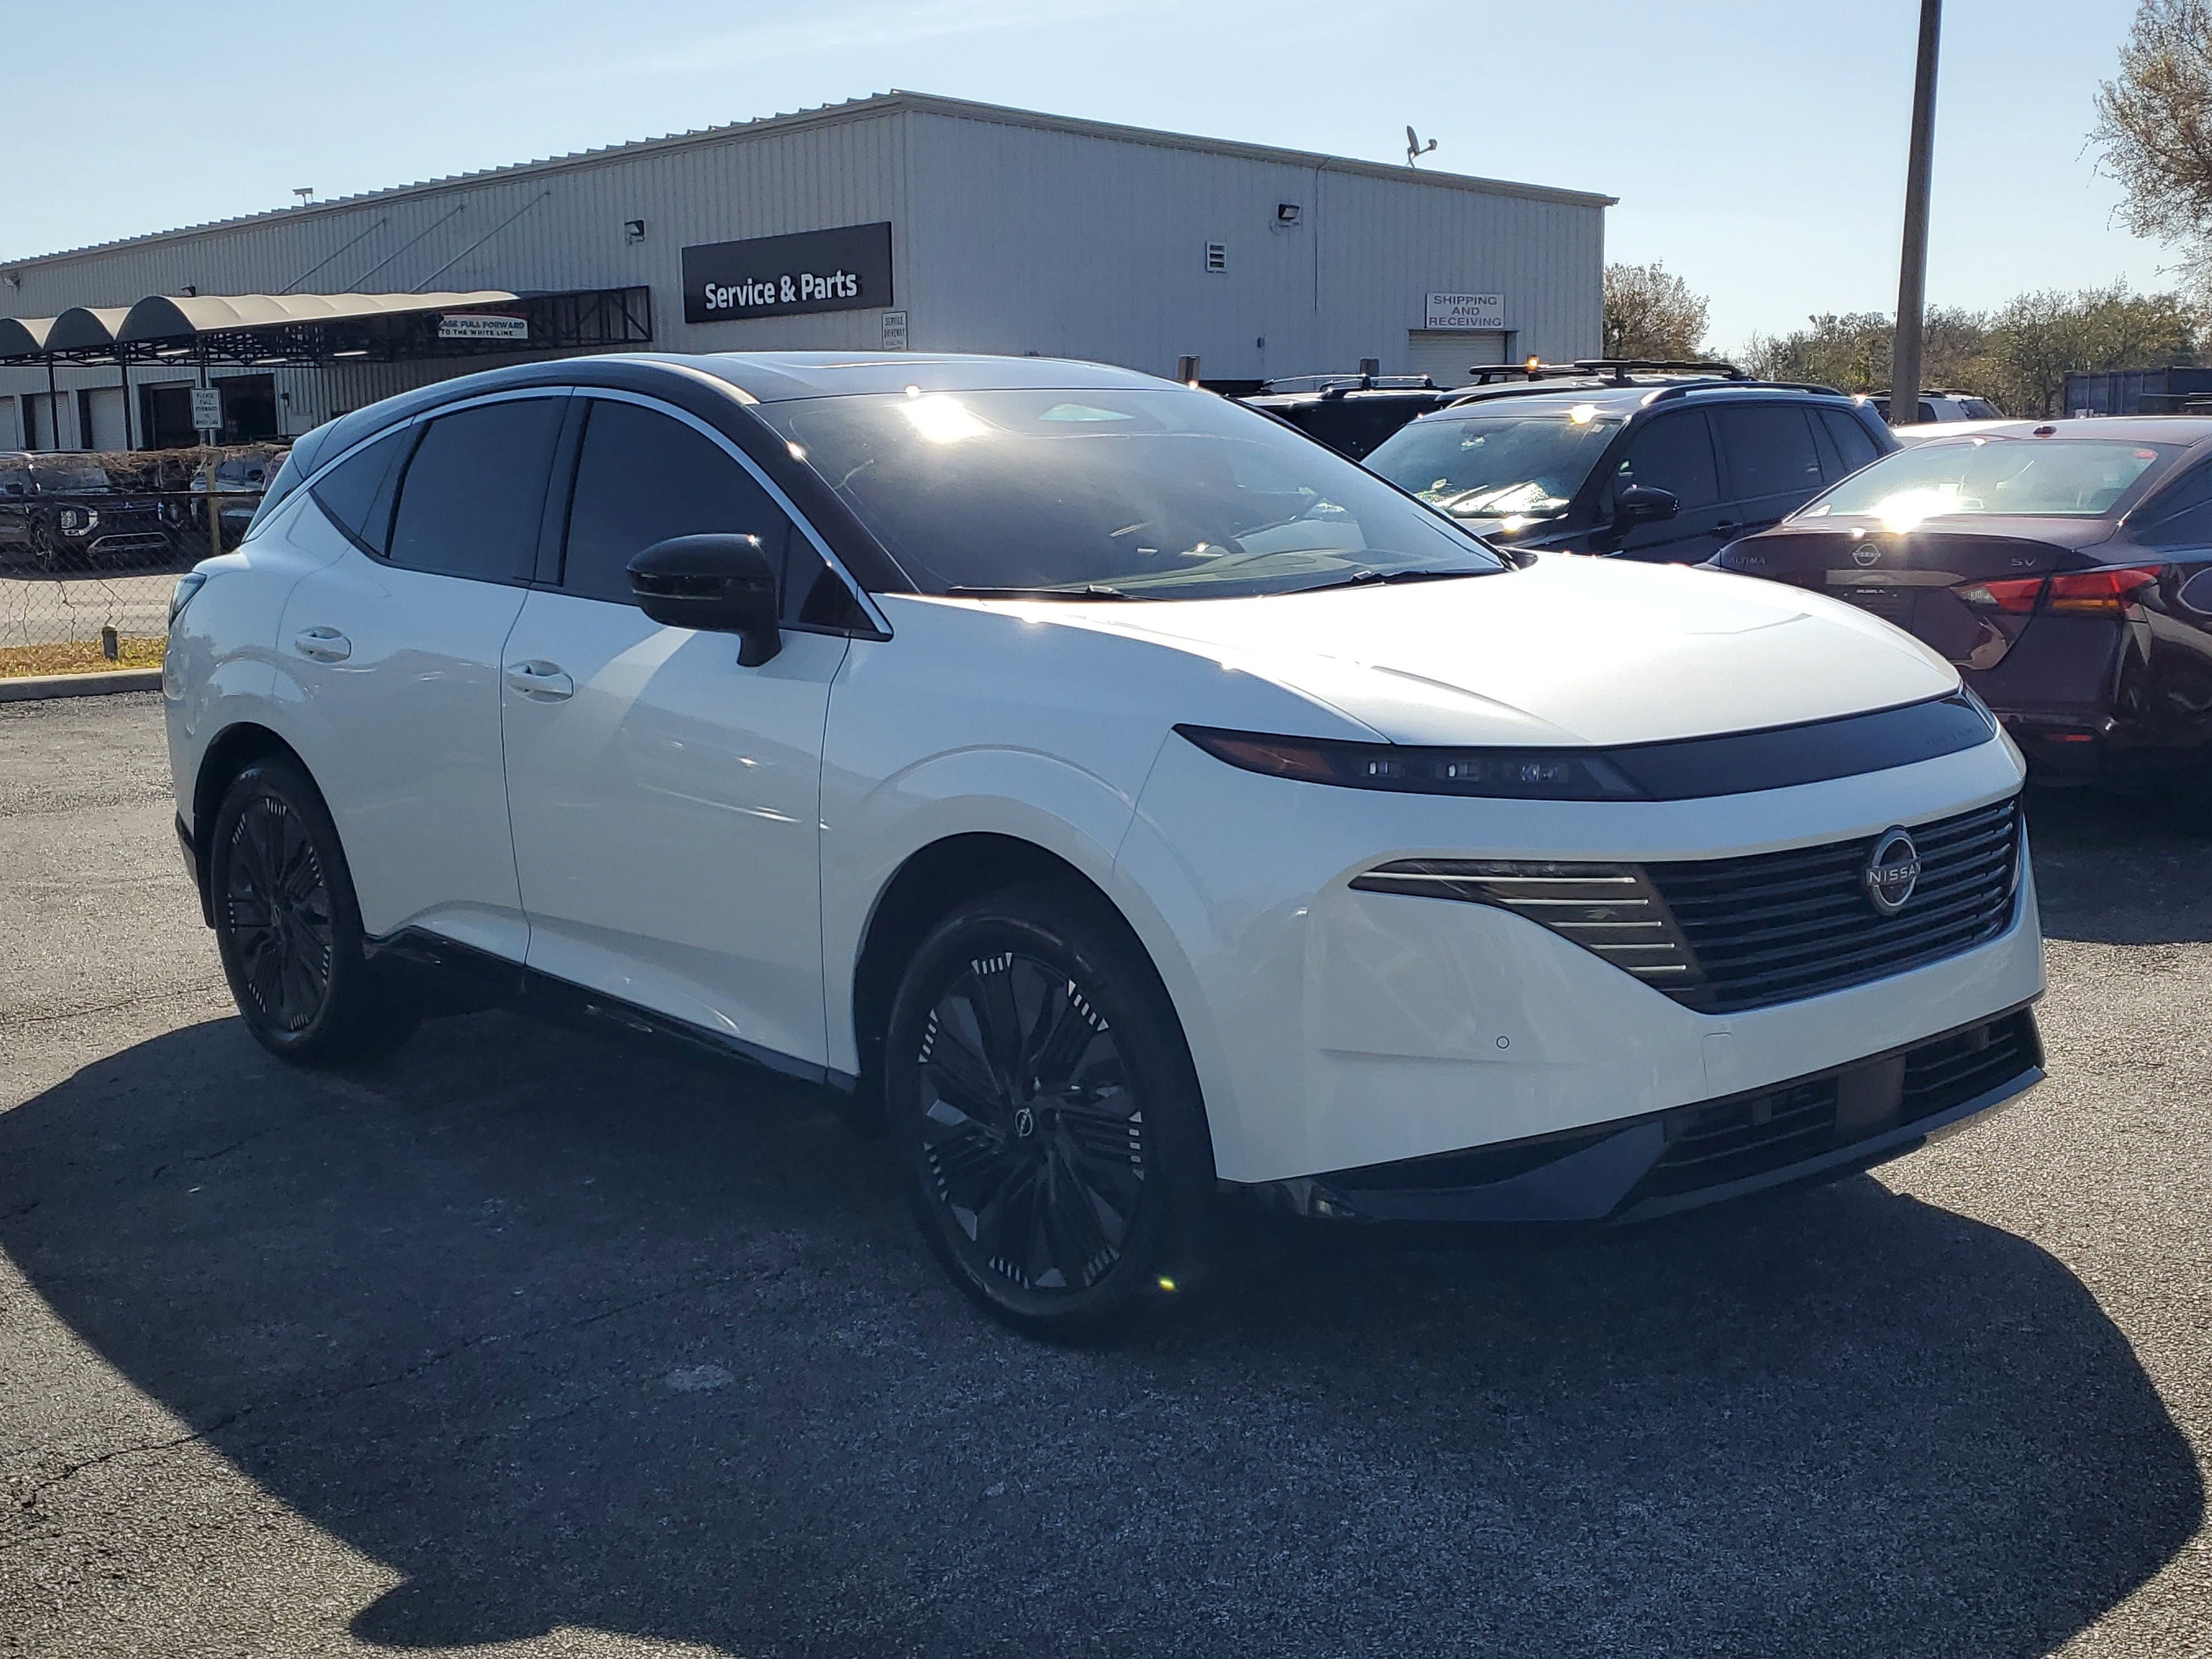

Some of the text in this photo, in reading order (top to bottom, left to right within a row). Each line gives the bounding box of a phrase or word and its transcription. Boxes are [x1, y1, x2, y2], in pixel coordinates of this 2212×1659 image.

[705, 270, 857, 309] Service & Parts
[1434, 296, 1497, 305] SHIPPING
[1452, 307, 1480, 315] AND
[482, 321, 524, 329] FORWARD
[1429, 317, 1502, 326] RECEIVING
[2011, 558, 2037, 566] SV
[1869, 861, 1921, 883] NISSAN
